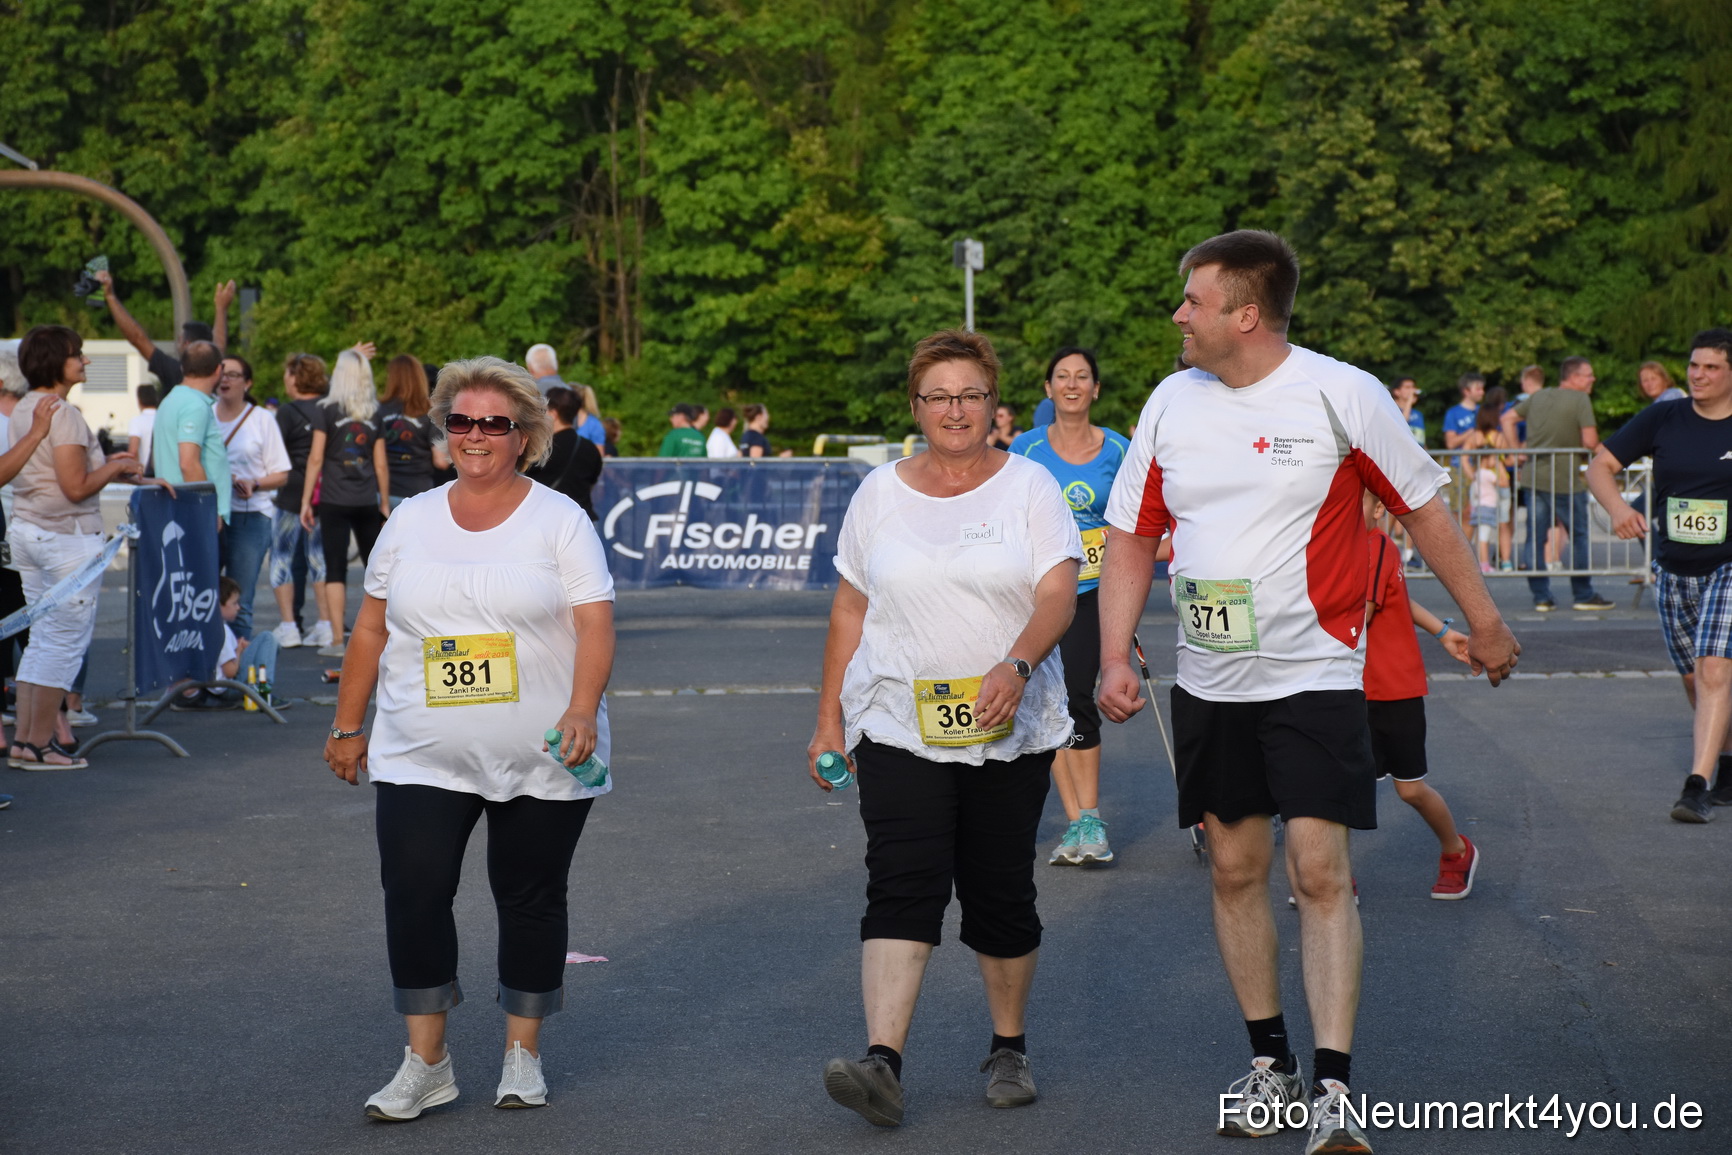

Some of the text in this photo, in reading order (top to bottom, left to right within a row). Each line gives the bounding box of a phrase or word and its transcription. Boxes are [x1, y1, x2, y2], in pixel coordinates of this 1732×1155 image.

[1271, 457, 1303, 467] Stefan
[1674, 514, 1718, 531] 1463
[644, 513, 828, 550] Fischer
[962, 526, 995, 540] Traudl
[660, 553, 812, 571] AUTOMOBILE
[1190, 603, 1229, 632] 371
[1196, 630, 1210, 639] Oppel
[1211, 632, 1232, 640] Stefan
[492, 651, 509, 659] 2019
[442, 659, 491, 687] 381
[449, 687, 469, 695] Zankl
[937, 703, 980, 729] 36
